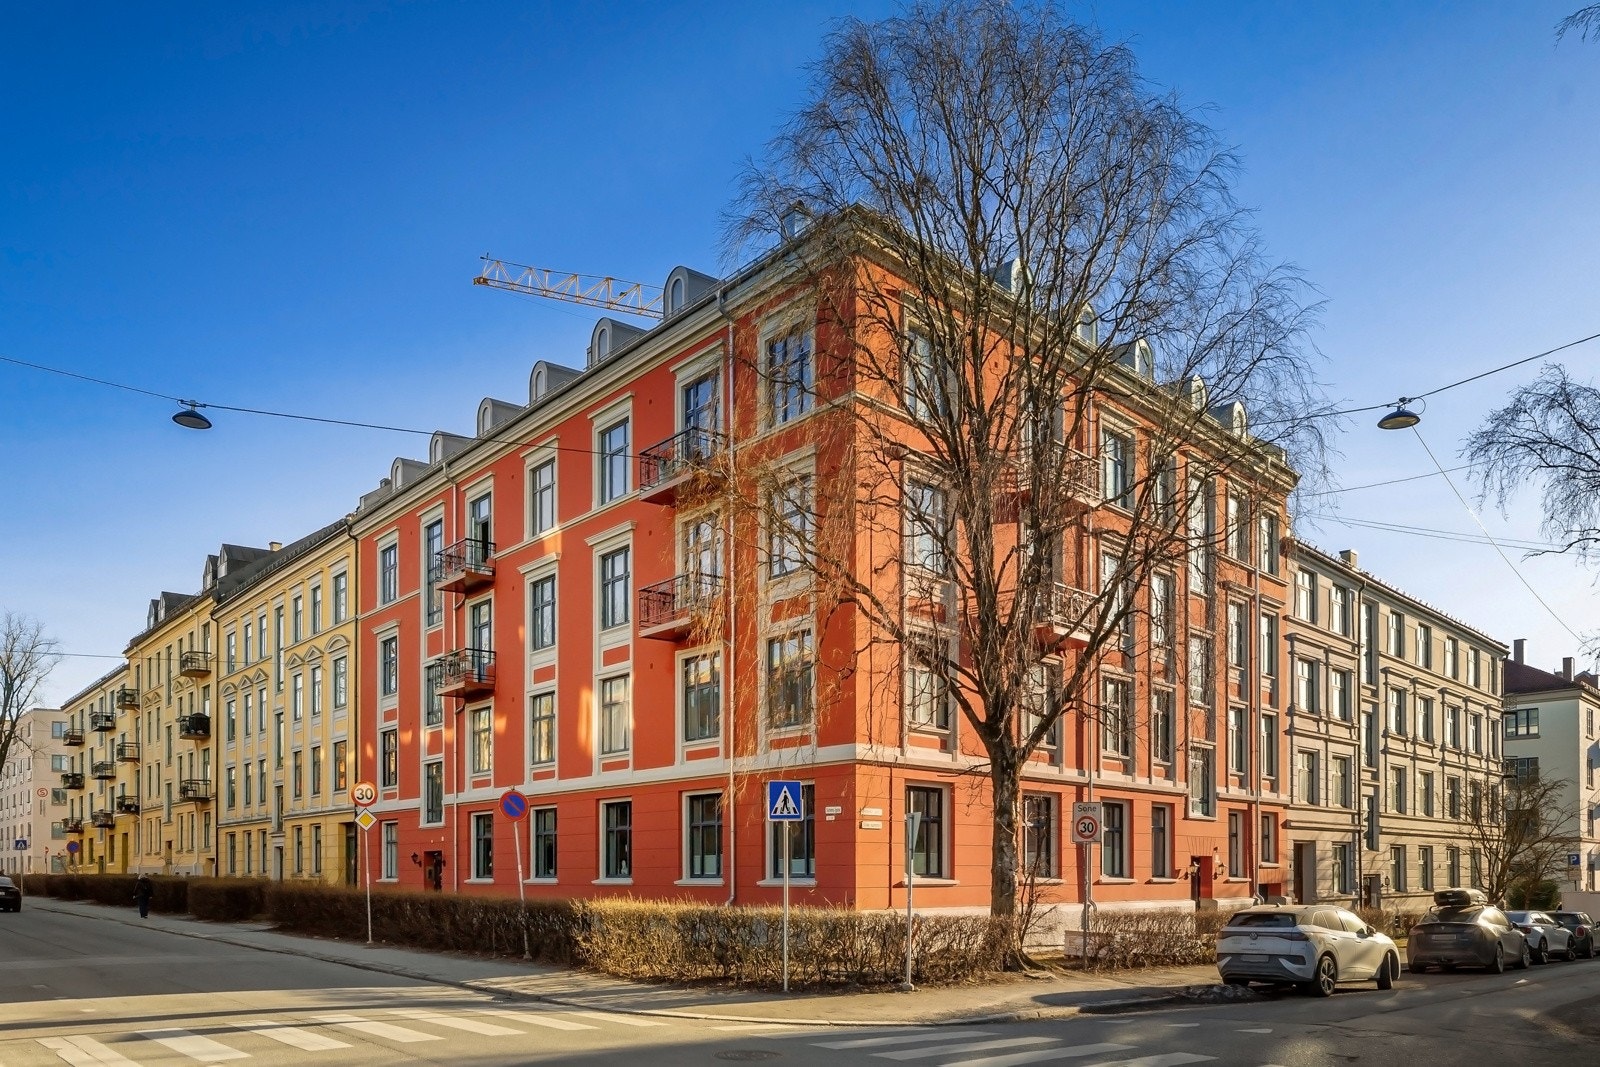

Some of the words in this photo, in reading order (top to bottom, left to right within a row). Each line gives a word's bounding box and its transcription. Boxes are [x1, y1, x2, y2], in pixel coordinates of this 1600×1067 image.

[356, 788, 374, 800] 30
[1077, 804, 1097, 812] Sone
[1080, 821, 1094, 833] 30
[1570, 856, 1577, 865] P
